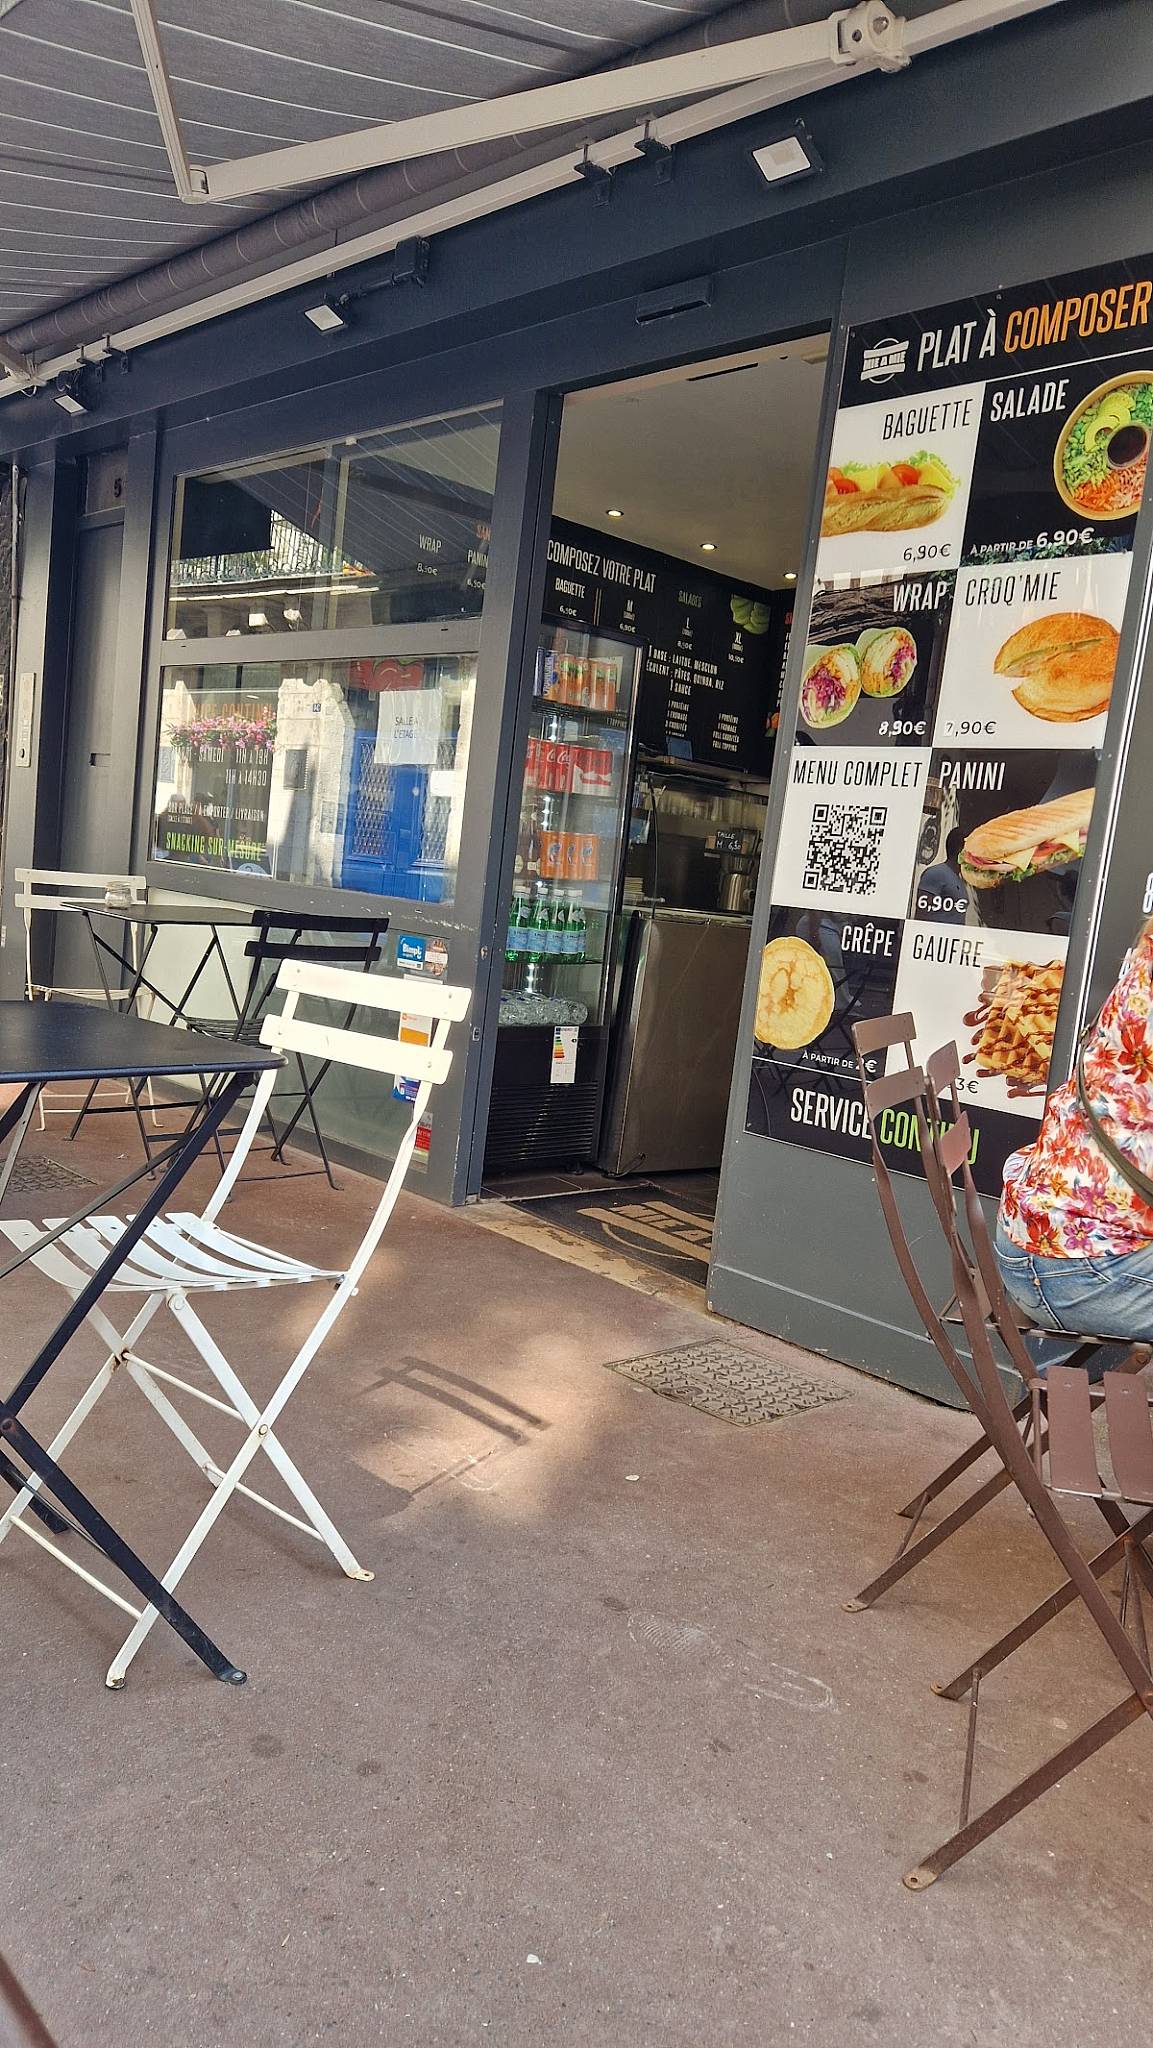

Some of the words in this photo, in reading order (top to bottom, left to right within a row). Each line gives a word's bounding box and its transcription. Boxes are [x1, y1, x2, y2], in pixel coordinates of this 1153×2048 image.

[917, 321, 977, 372] PLAT
[979, 308, 997, 359] À
[1004, 280, 1153, 353] COMPOSER
[990, 379, 1070, 422] SALADE
[882, 399, 973, 441] BAGUETTE
[420, 534, 442, 553] WRAP
[903, 544, 951, 562] 6,90€
[980, 541, 1016, 554] PARTIR
[1018, 539, 1033, 550] DE
[547, 539, 601, 576] COMPOSEZ
[602, 557, 632, 586] VOTRE
[633, 568, 657, 593] PLAT
[555, 577, 585, 599] BAGUETTE
[893, 581, 948, 613] WRAP
[965, 572, 1061, 606] CROQ'MIE
[653, 648, 668, 662] BASE
[675, 683, 692, 695] SAUCE
[878, 721, 927, 738] 8,90€
[944, 721, 997, 737] 7,90€
[245, 769, 267, 786] 14H30
[793, 760, 838, 785] MENU
[843, 761, 922, 788] COMPLET
[938, 761, 1006, 791] PANINI
[166, 832, 205, 854] SNACKING
[918, 895, 968, 914] 6,90€
[841, 922, 895, 957] CRÊPE
[912, 934, 984, 968] GAUFRE
[802, 1049, 809, 1060] À
[811, 1053, 840, 1066] PARTIR
[842, 1060, 854, 1069] DE
